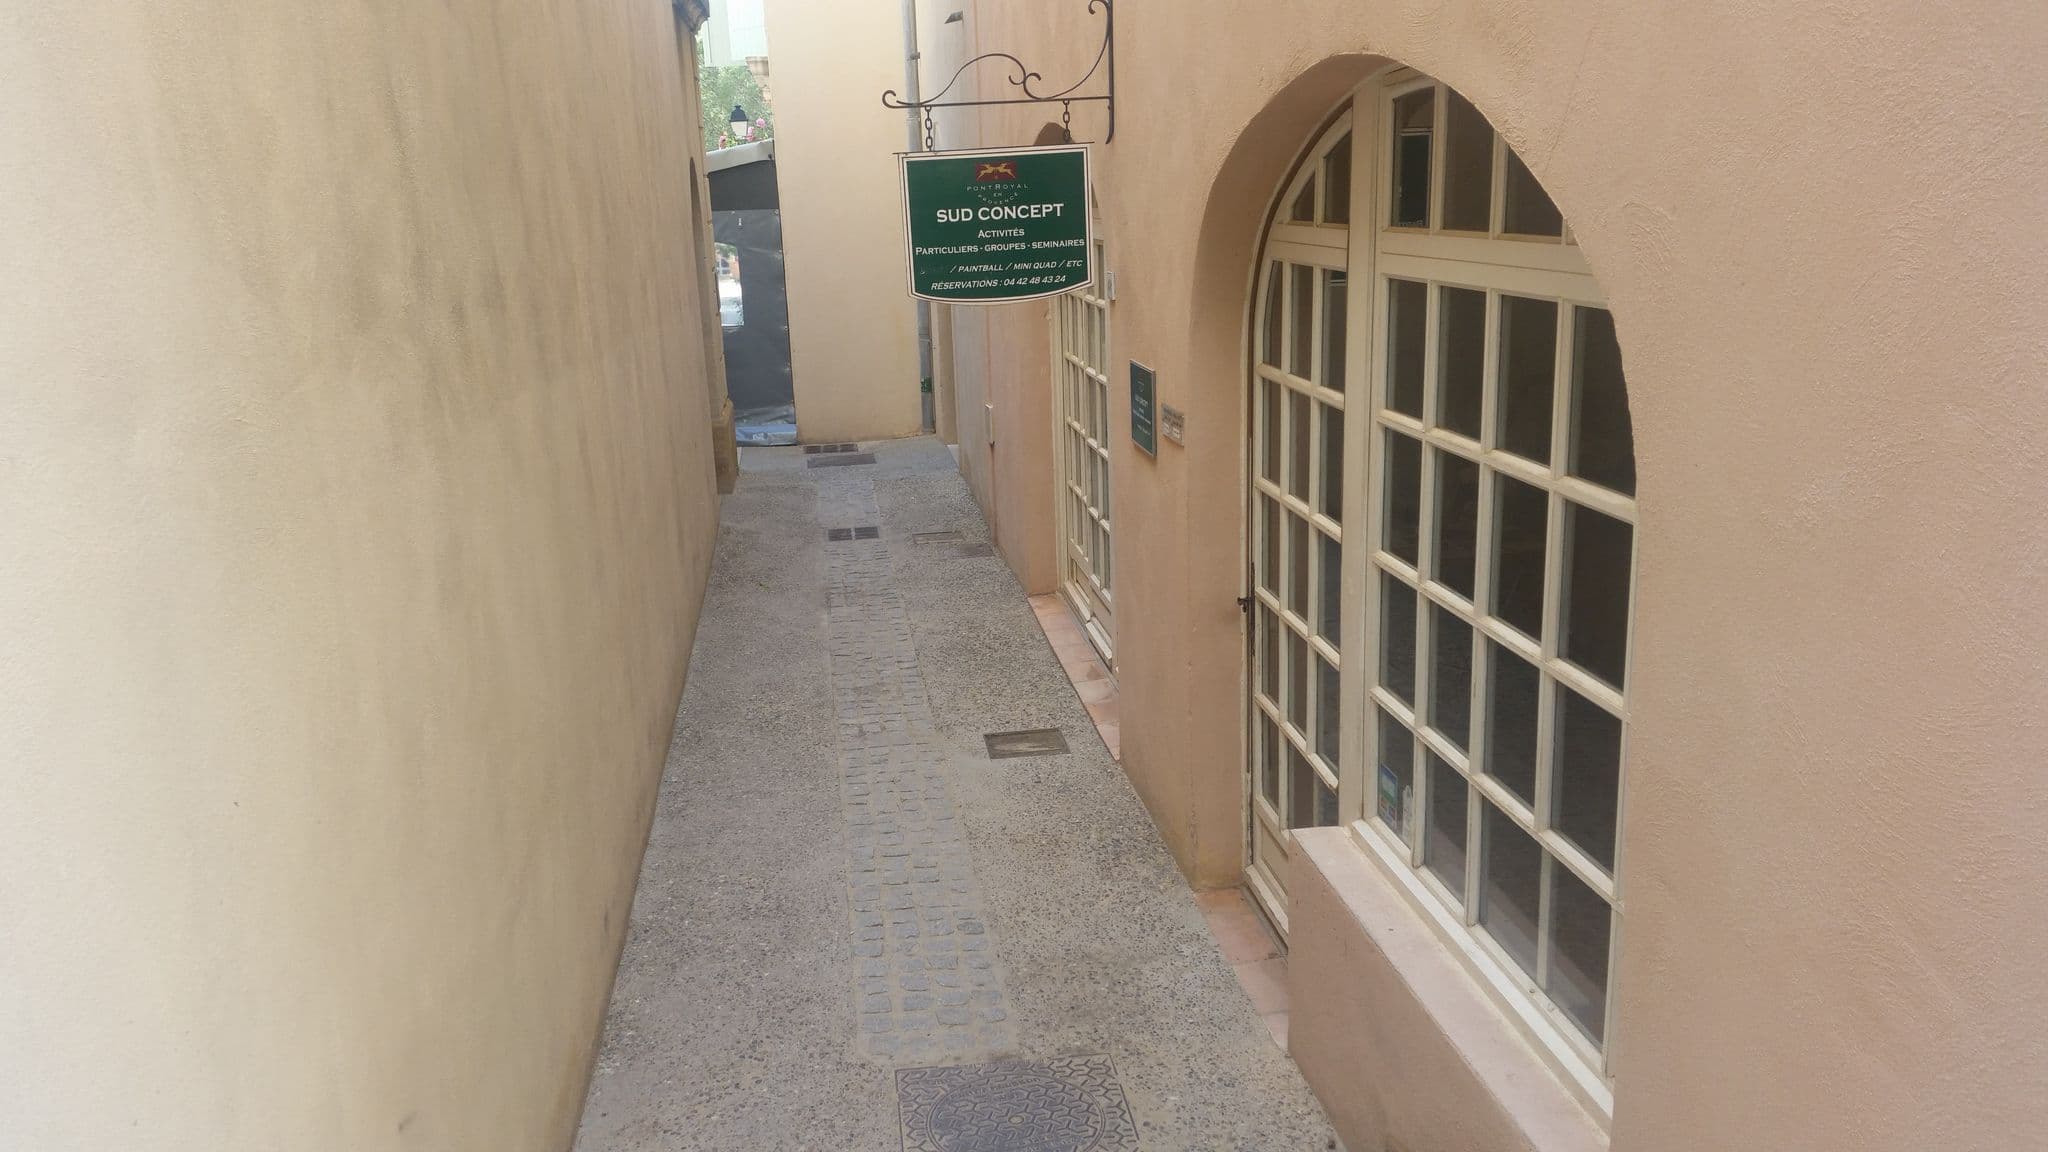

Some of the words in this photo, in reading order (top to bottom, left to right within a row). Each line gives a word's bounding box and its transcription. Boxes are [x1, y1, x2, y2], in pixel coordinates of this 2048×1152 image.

[936, 208, 973, 223] SUD
[977, 203, 1064, 221] CONCEPT
[977, 227, 1025, 239] ACTIVITÉS
[915, 245, 979, 255] PARTICULIERS
[984, 242, 1026, 252] GROUPES
[1031, 239, 1085, 249] SEMINAIRES
[958, 263, 1004, 273] PAINTBALL
[1013, 262, 1031, 270] MINI
[1033, 261, 1057, 269] QUAD
[1066, 259, 1083, 268] ETC
[1003, 278, 1015, 286] 04
[1016, 277, 1028, 285] 42
[1029, 276, 1041, 284] 48
[1041, 275, 1053, 283] 43
[1054, 274, 1066, 283] 24
